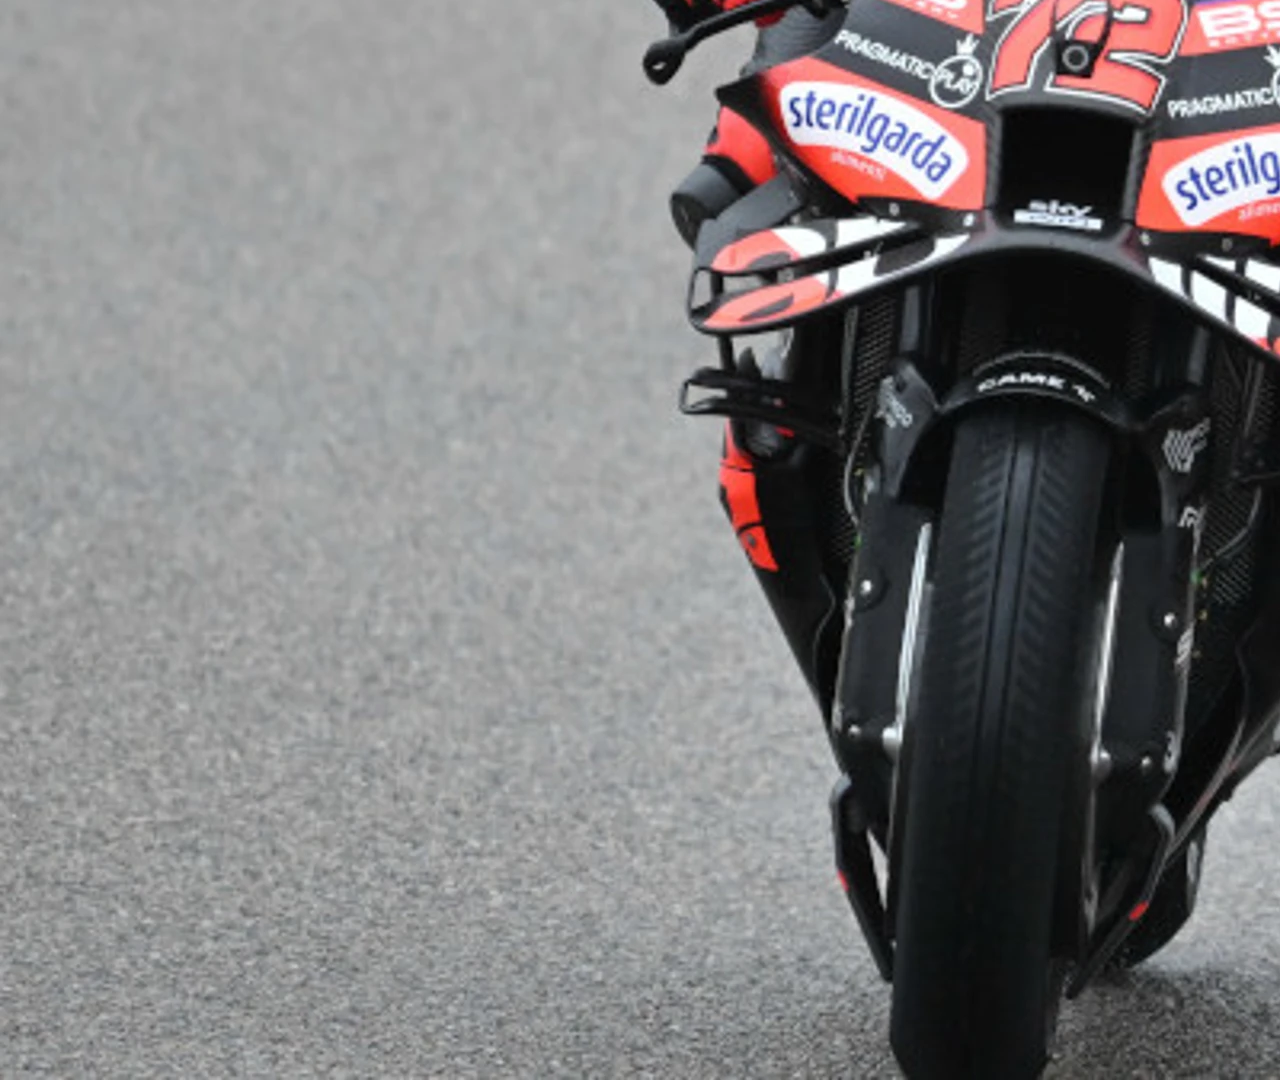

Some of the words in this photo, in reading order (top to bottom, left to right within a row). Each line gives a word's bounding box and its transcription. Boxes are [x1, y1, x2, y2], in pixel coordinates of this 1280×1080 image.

[833, 29, 936, 80] PRAGMATIC
[1167, 88, 1276, 119] PRAGMATIC
[788, 89, 953, 184] sterilgarda
